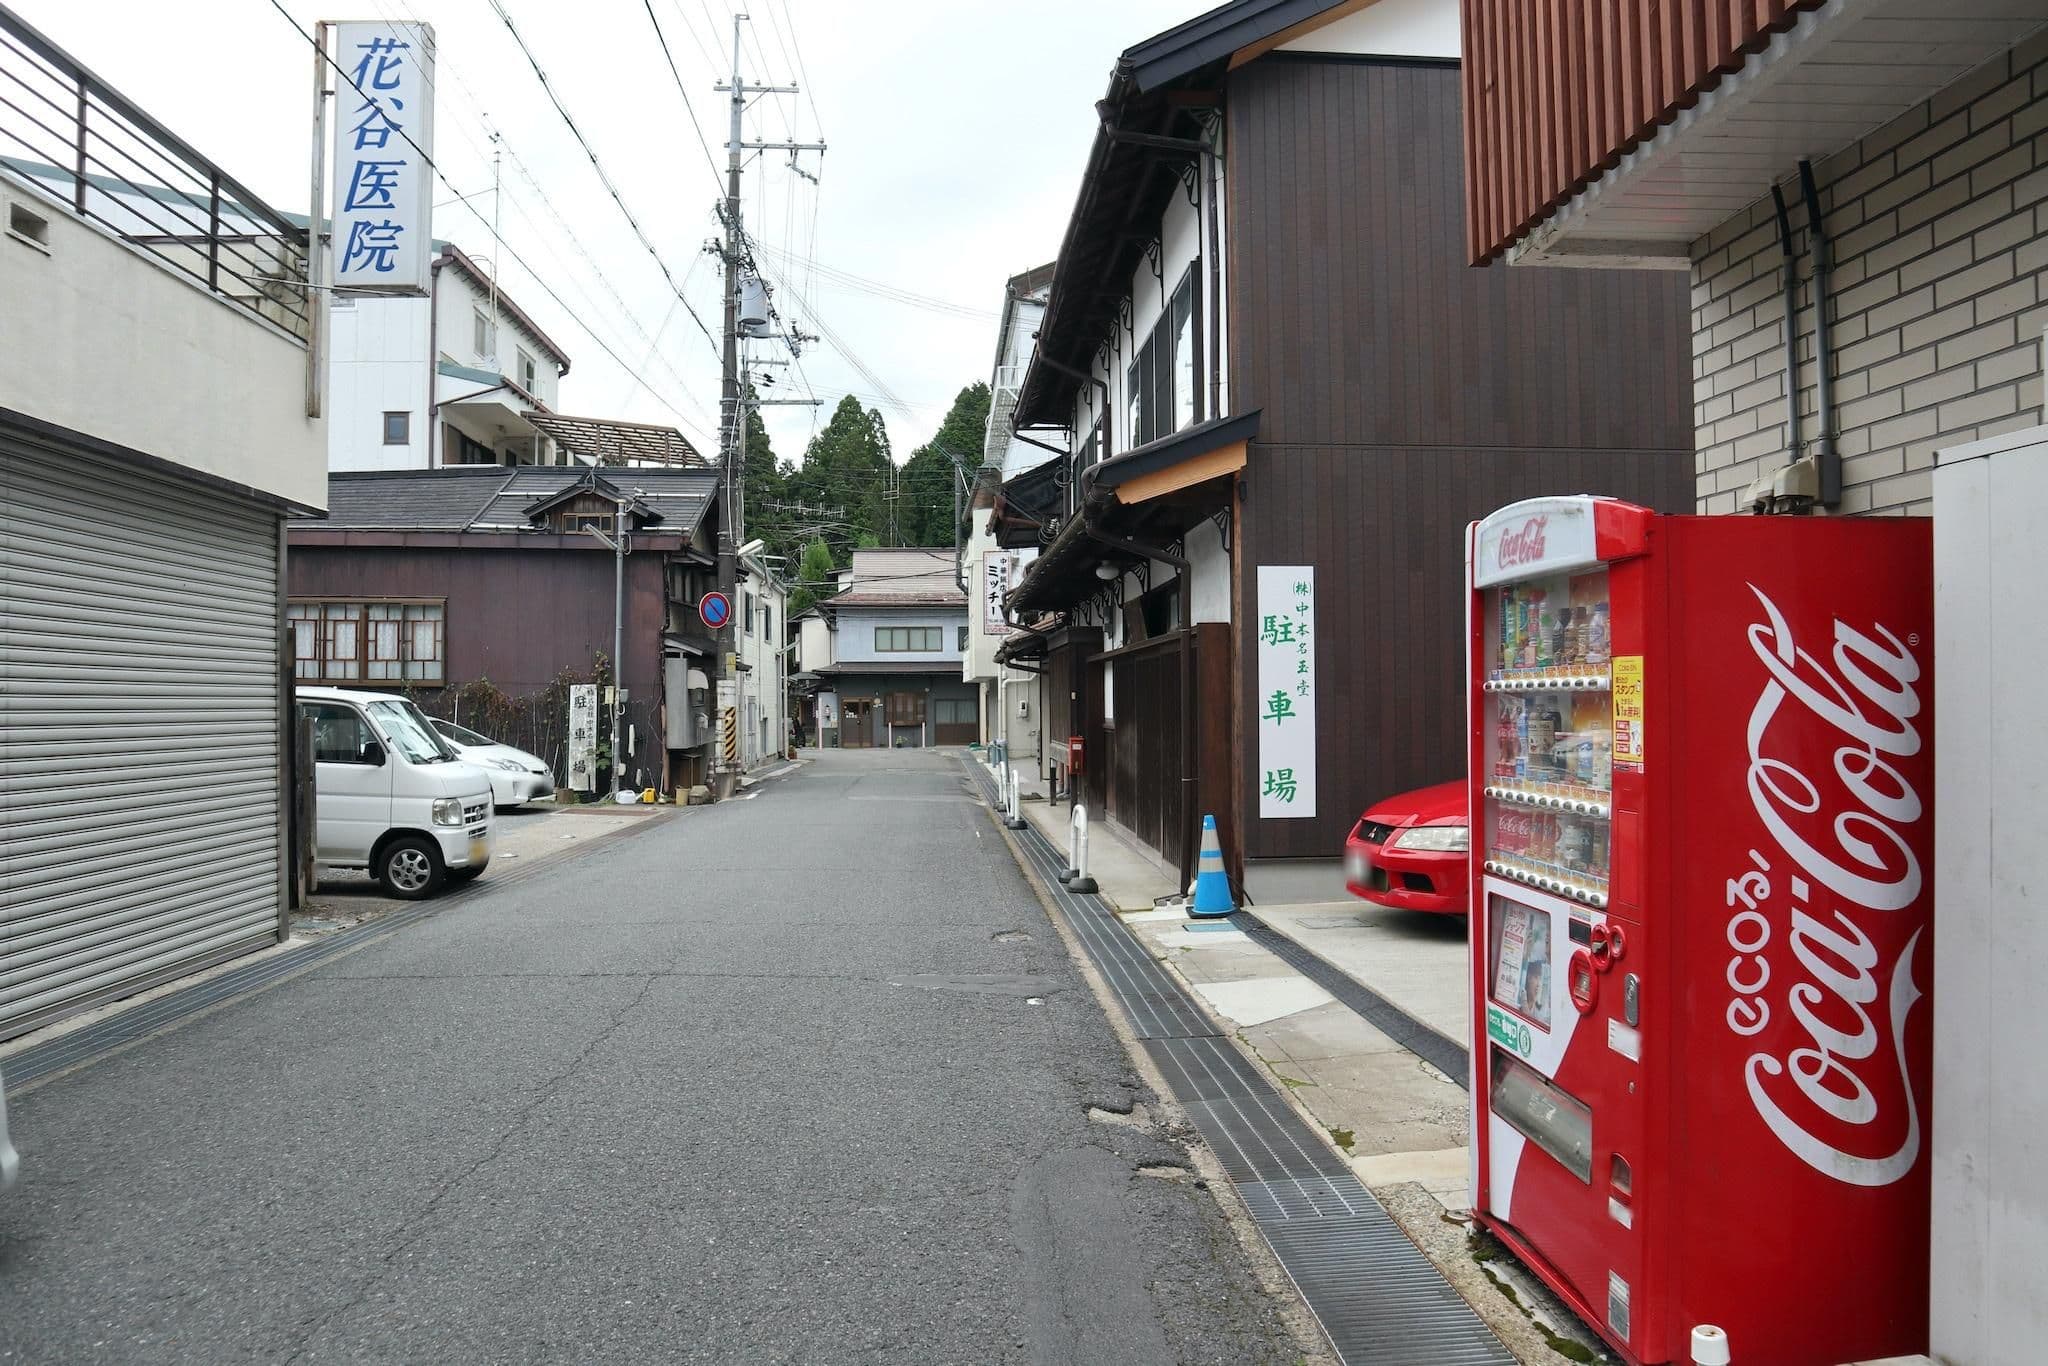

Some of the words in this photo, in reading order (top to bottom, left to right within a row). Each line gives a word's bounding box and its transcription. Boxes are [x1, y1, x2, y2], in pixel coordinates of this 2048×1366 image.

[341, 37, 410, 273] 花谷医院
[988, 565, 999, 616] ミッチー
[1498, 516, 1547, 570] Coca-Cola
[573, 695, 587, 773] 駐車場
[1260, 614, 1297, 804] 駐車場
[1745, 580, 1923, 1187] Coca-Cola
